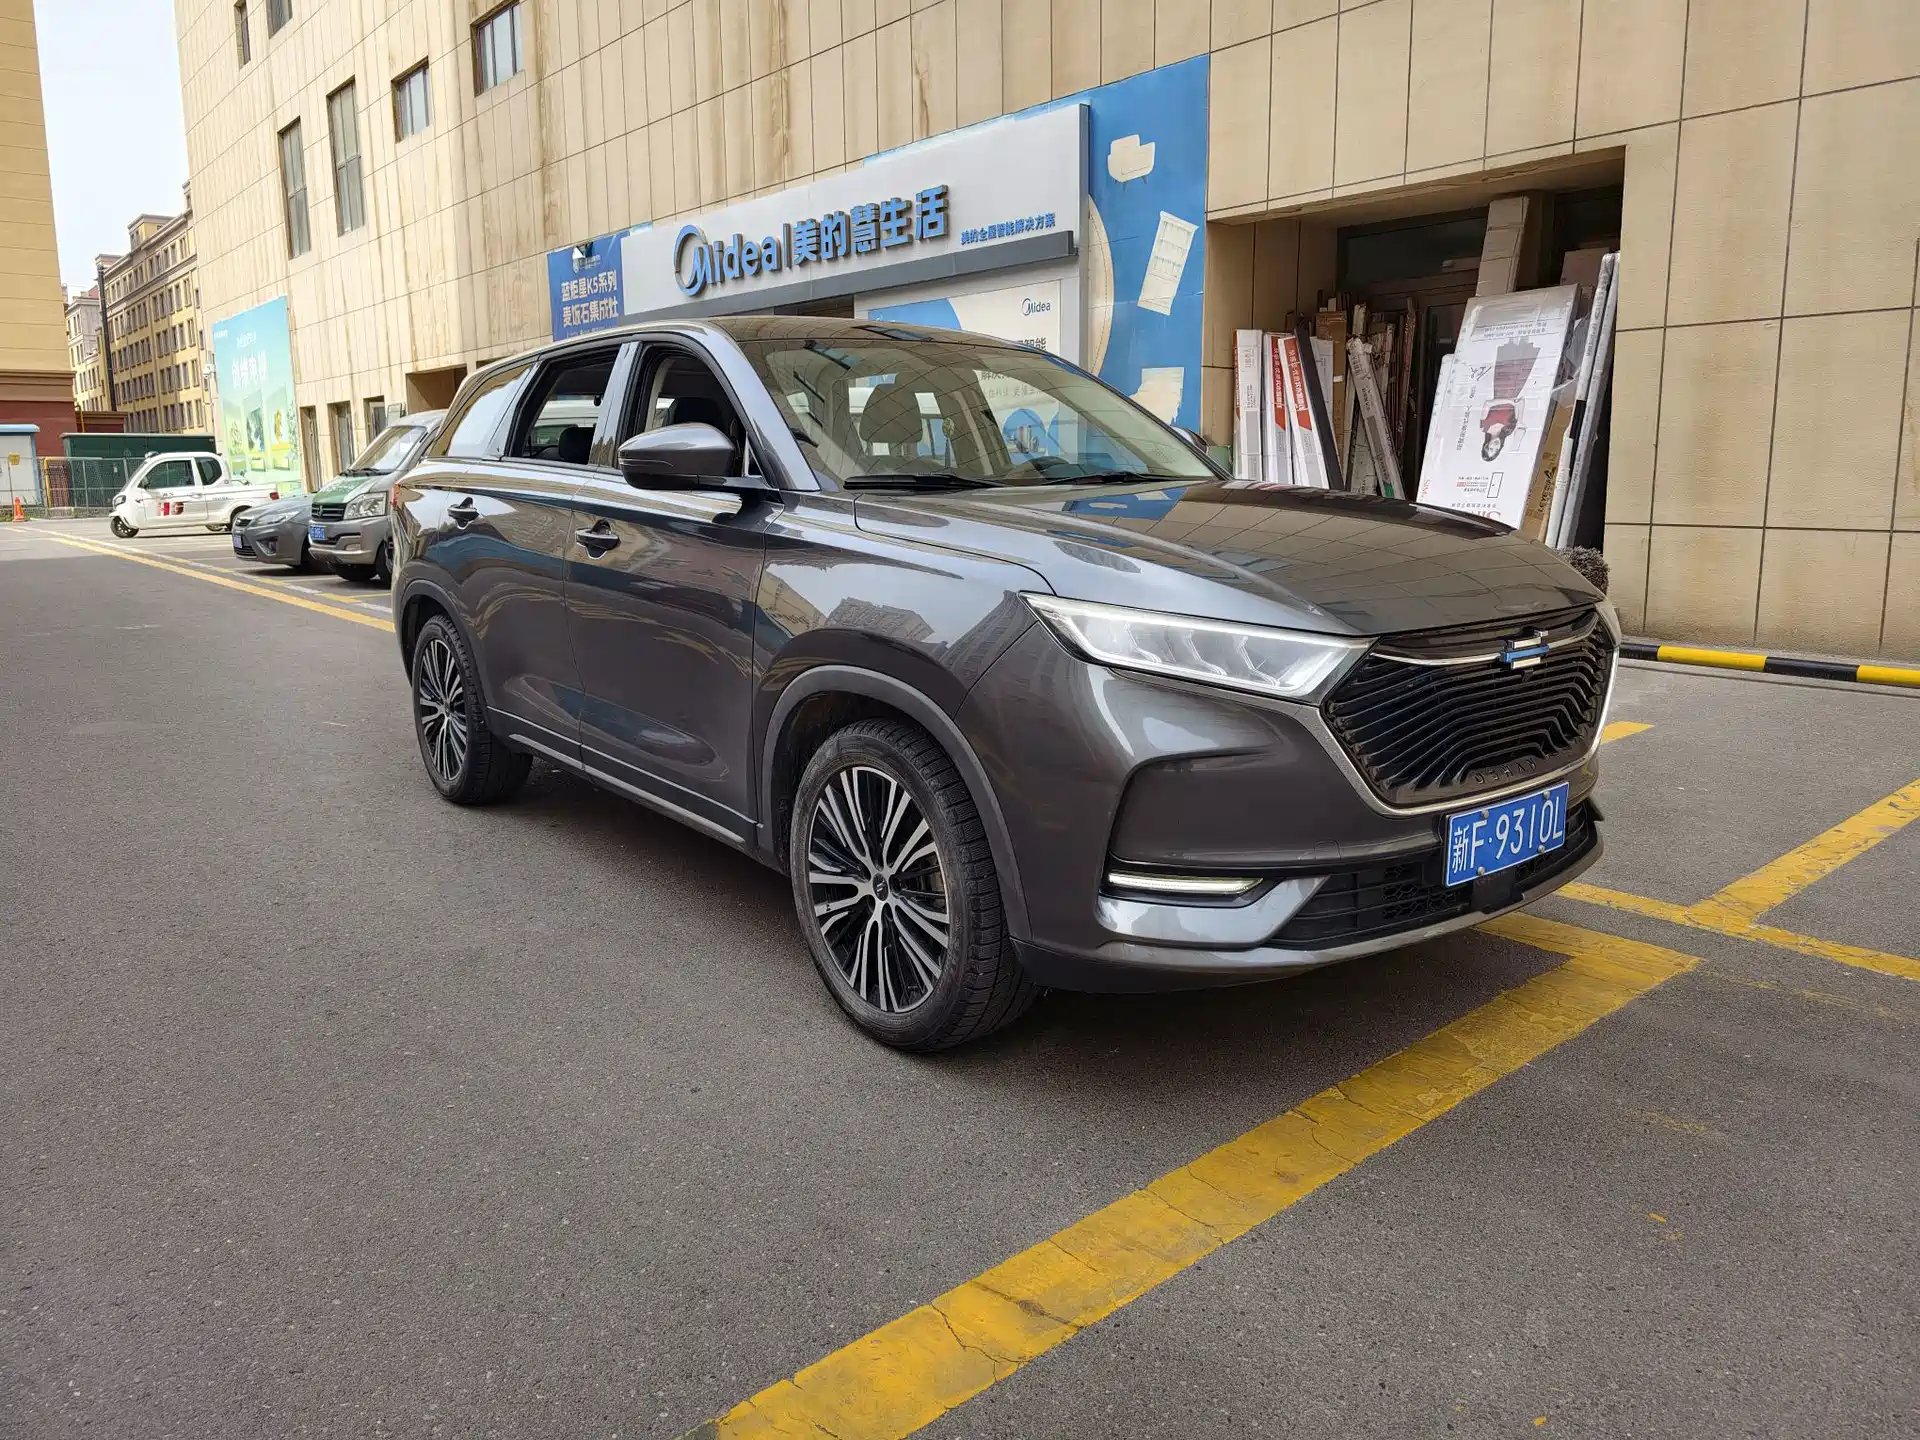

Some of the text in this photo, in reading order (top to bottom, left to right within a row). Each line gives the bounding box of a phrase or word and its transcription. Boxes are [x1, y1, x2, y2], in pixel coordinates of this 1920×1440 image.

[674, 184, 948, 297] Midea 美的慧生活
[961, 211, 1056, 245] 美的全屋智能解决方案
[561, 270, 617, 301] 蓝炬星K5系列
[563, 296, 619, 327] 麦饭石集成灶
[1022, 298, 1051, 316] Midea
[1017, 337, 1047, 351] 智能
